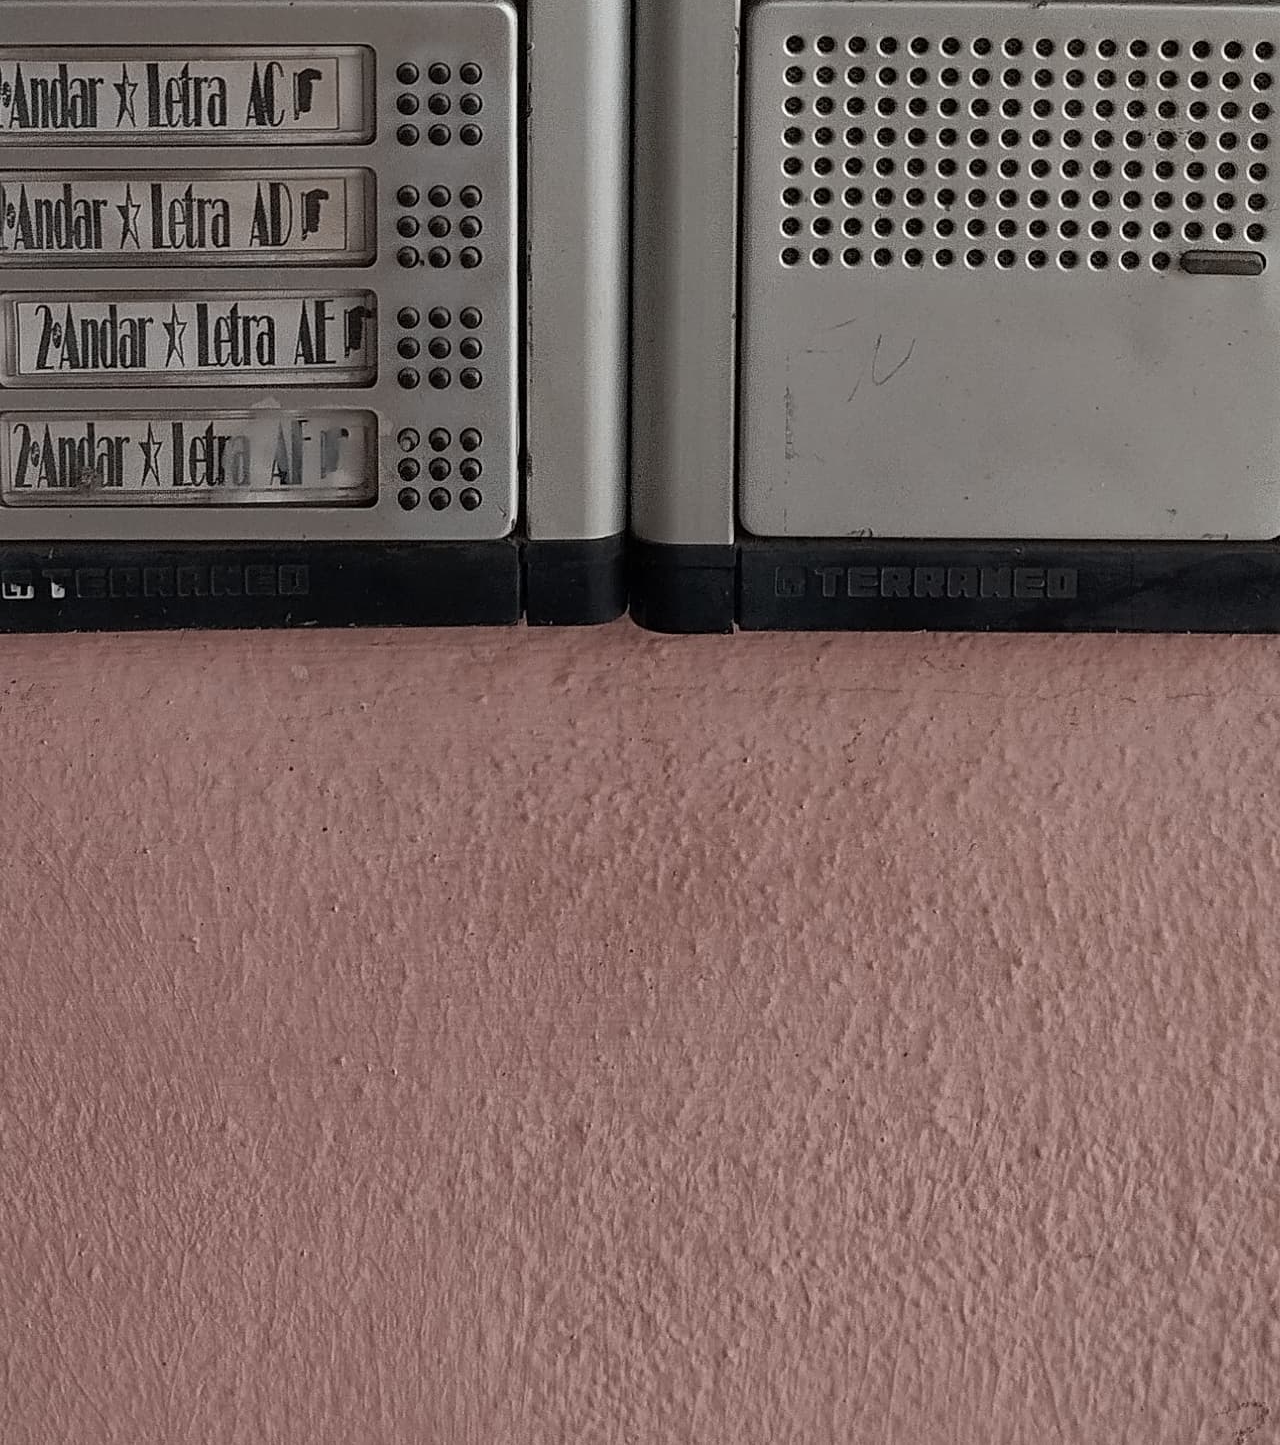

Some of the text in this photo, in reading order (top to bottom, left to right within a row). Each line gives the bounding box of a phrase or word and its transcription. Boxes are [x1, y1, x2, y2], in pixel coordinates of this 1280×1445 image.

[147, 62, 227, 129] Letra
[246, 61, 285, 127] AC
[151, 182, 231, 249] Letra
[250, 181, 293, 247] AD
[196, 302, 276, 368] Letra
[294, 299, 337, 366] AE
[171, 421, 251, 488] Letra
[271, 419, 312, 486] AF
[816, 566, 1079, 599] TERRANEO
